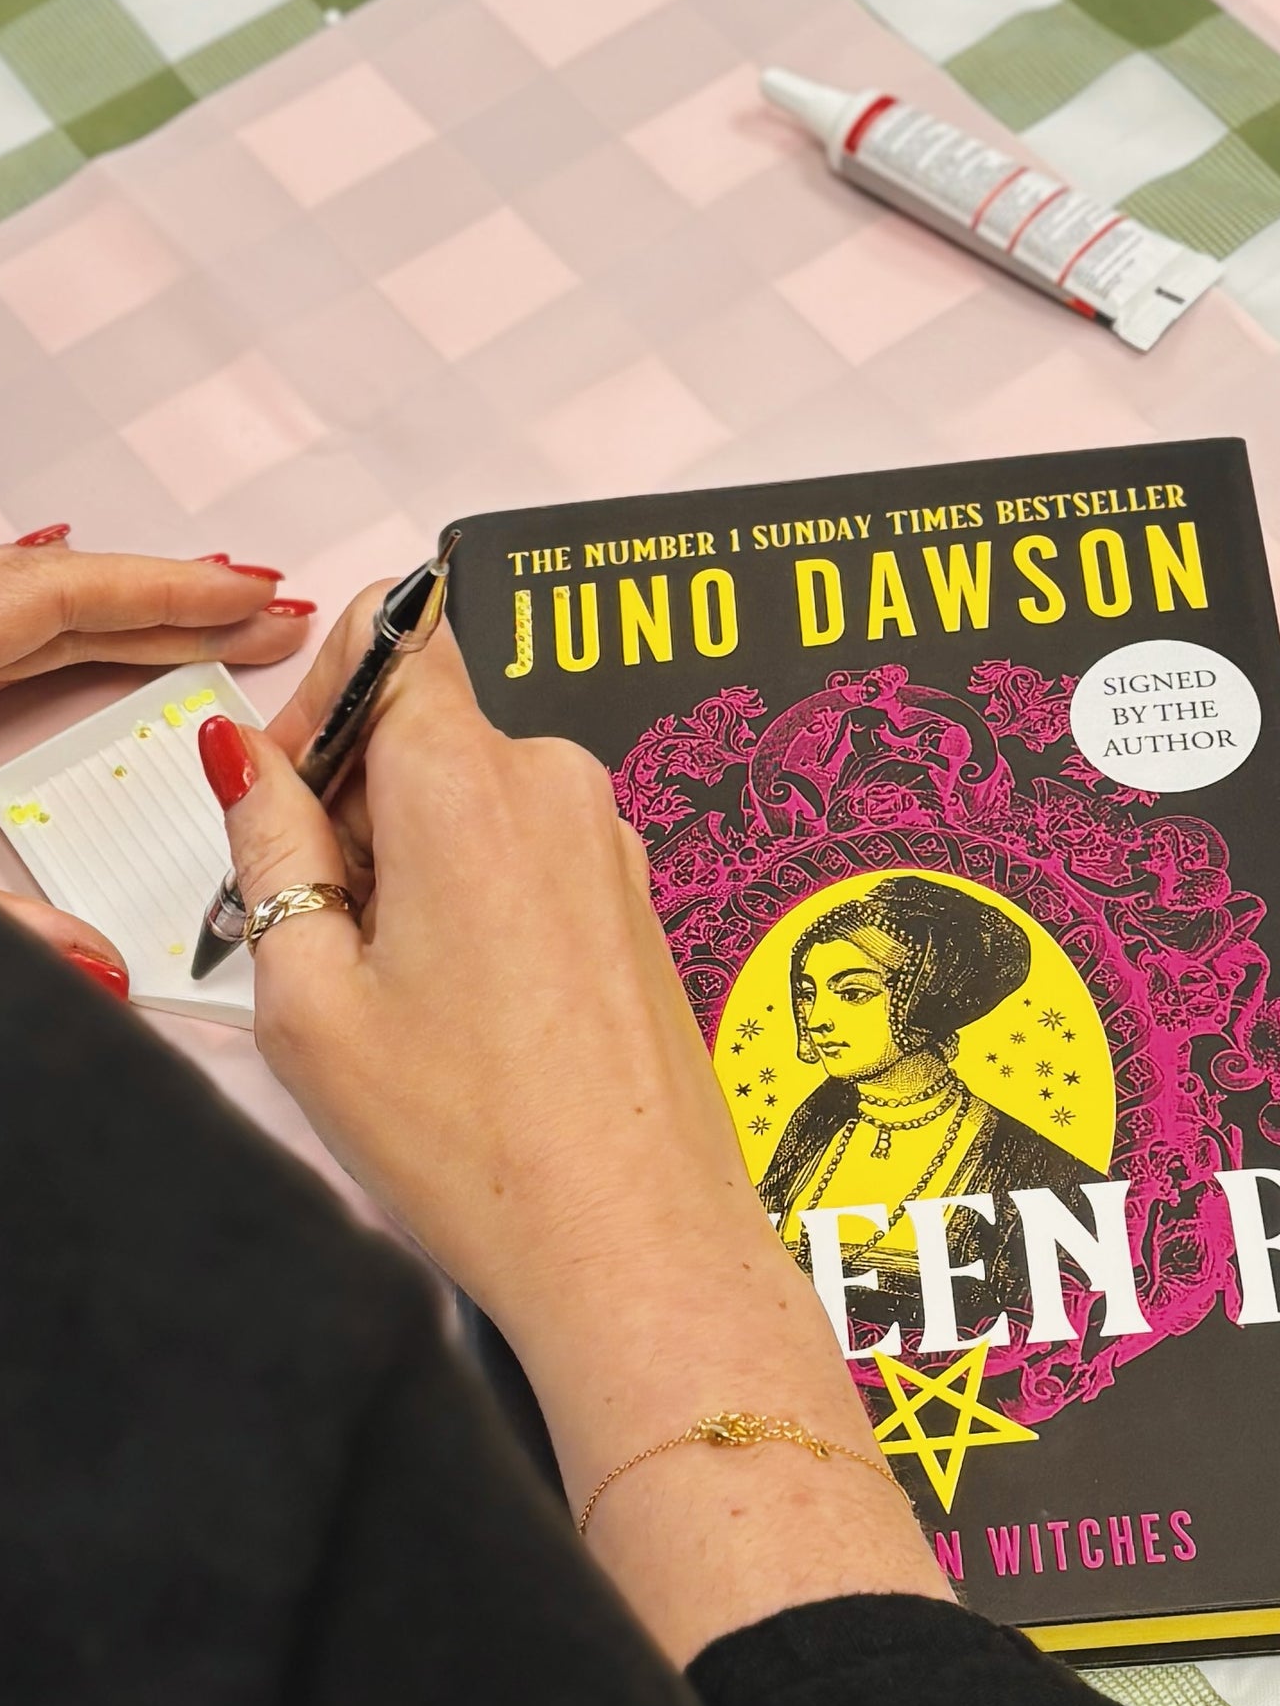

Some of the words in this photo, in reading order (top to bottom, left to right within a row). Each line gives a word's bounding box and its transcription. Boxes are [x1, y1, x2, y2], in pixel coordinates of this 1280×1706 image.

[507, 546, 572, 577] THE
[583, 530, 717, 569] NUMBER
[729, 527, 742, 553] 1
[751, 513, 872, 551] SUNDAY
[885, 502, 985, 536] TIMES
[996, 483, 1188, 525] BESTSELLER
[504, 567, 740, 680] JUNO
[793, 520, 1210, 649] DAWSON
[1103, 669, 1217, 696] SIGNED
[1111, 704, 1147, 726] BY
[1153, 699, 1219, 722] THE
[1102, 728, 1238, 758] AUTHOR
[768, 1179, 1154, 1360] EEN
[985, 1509, 1198, 1577] WITCHES
